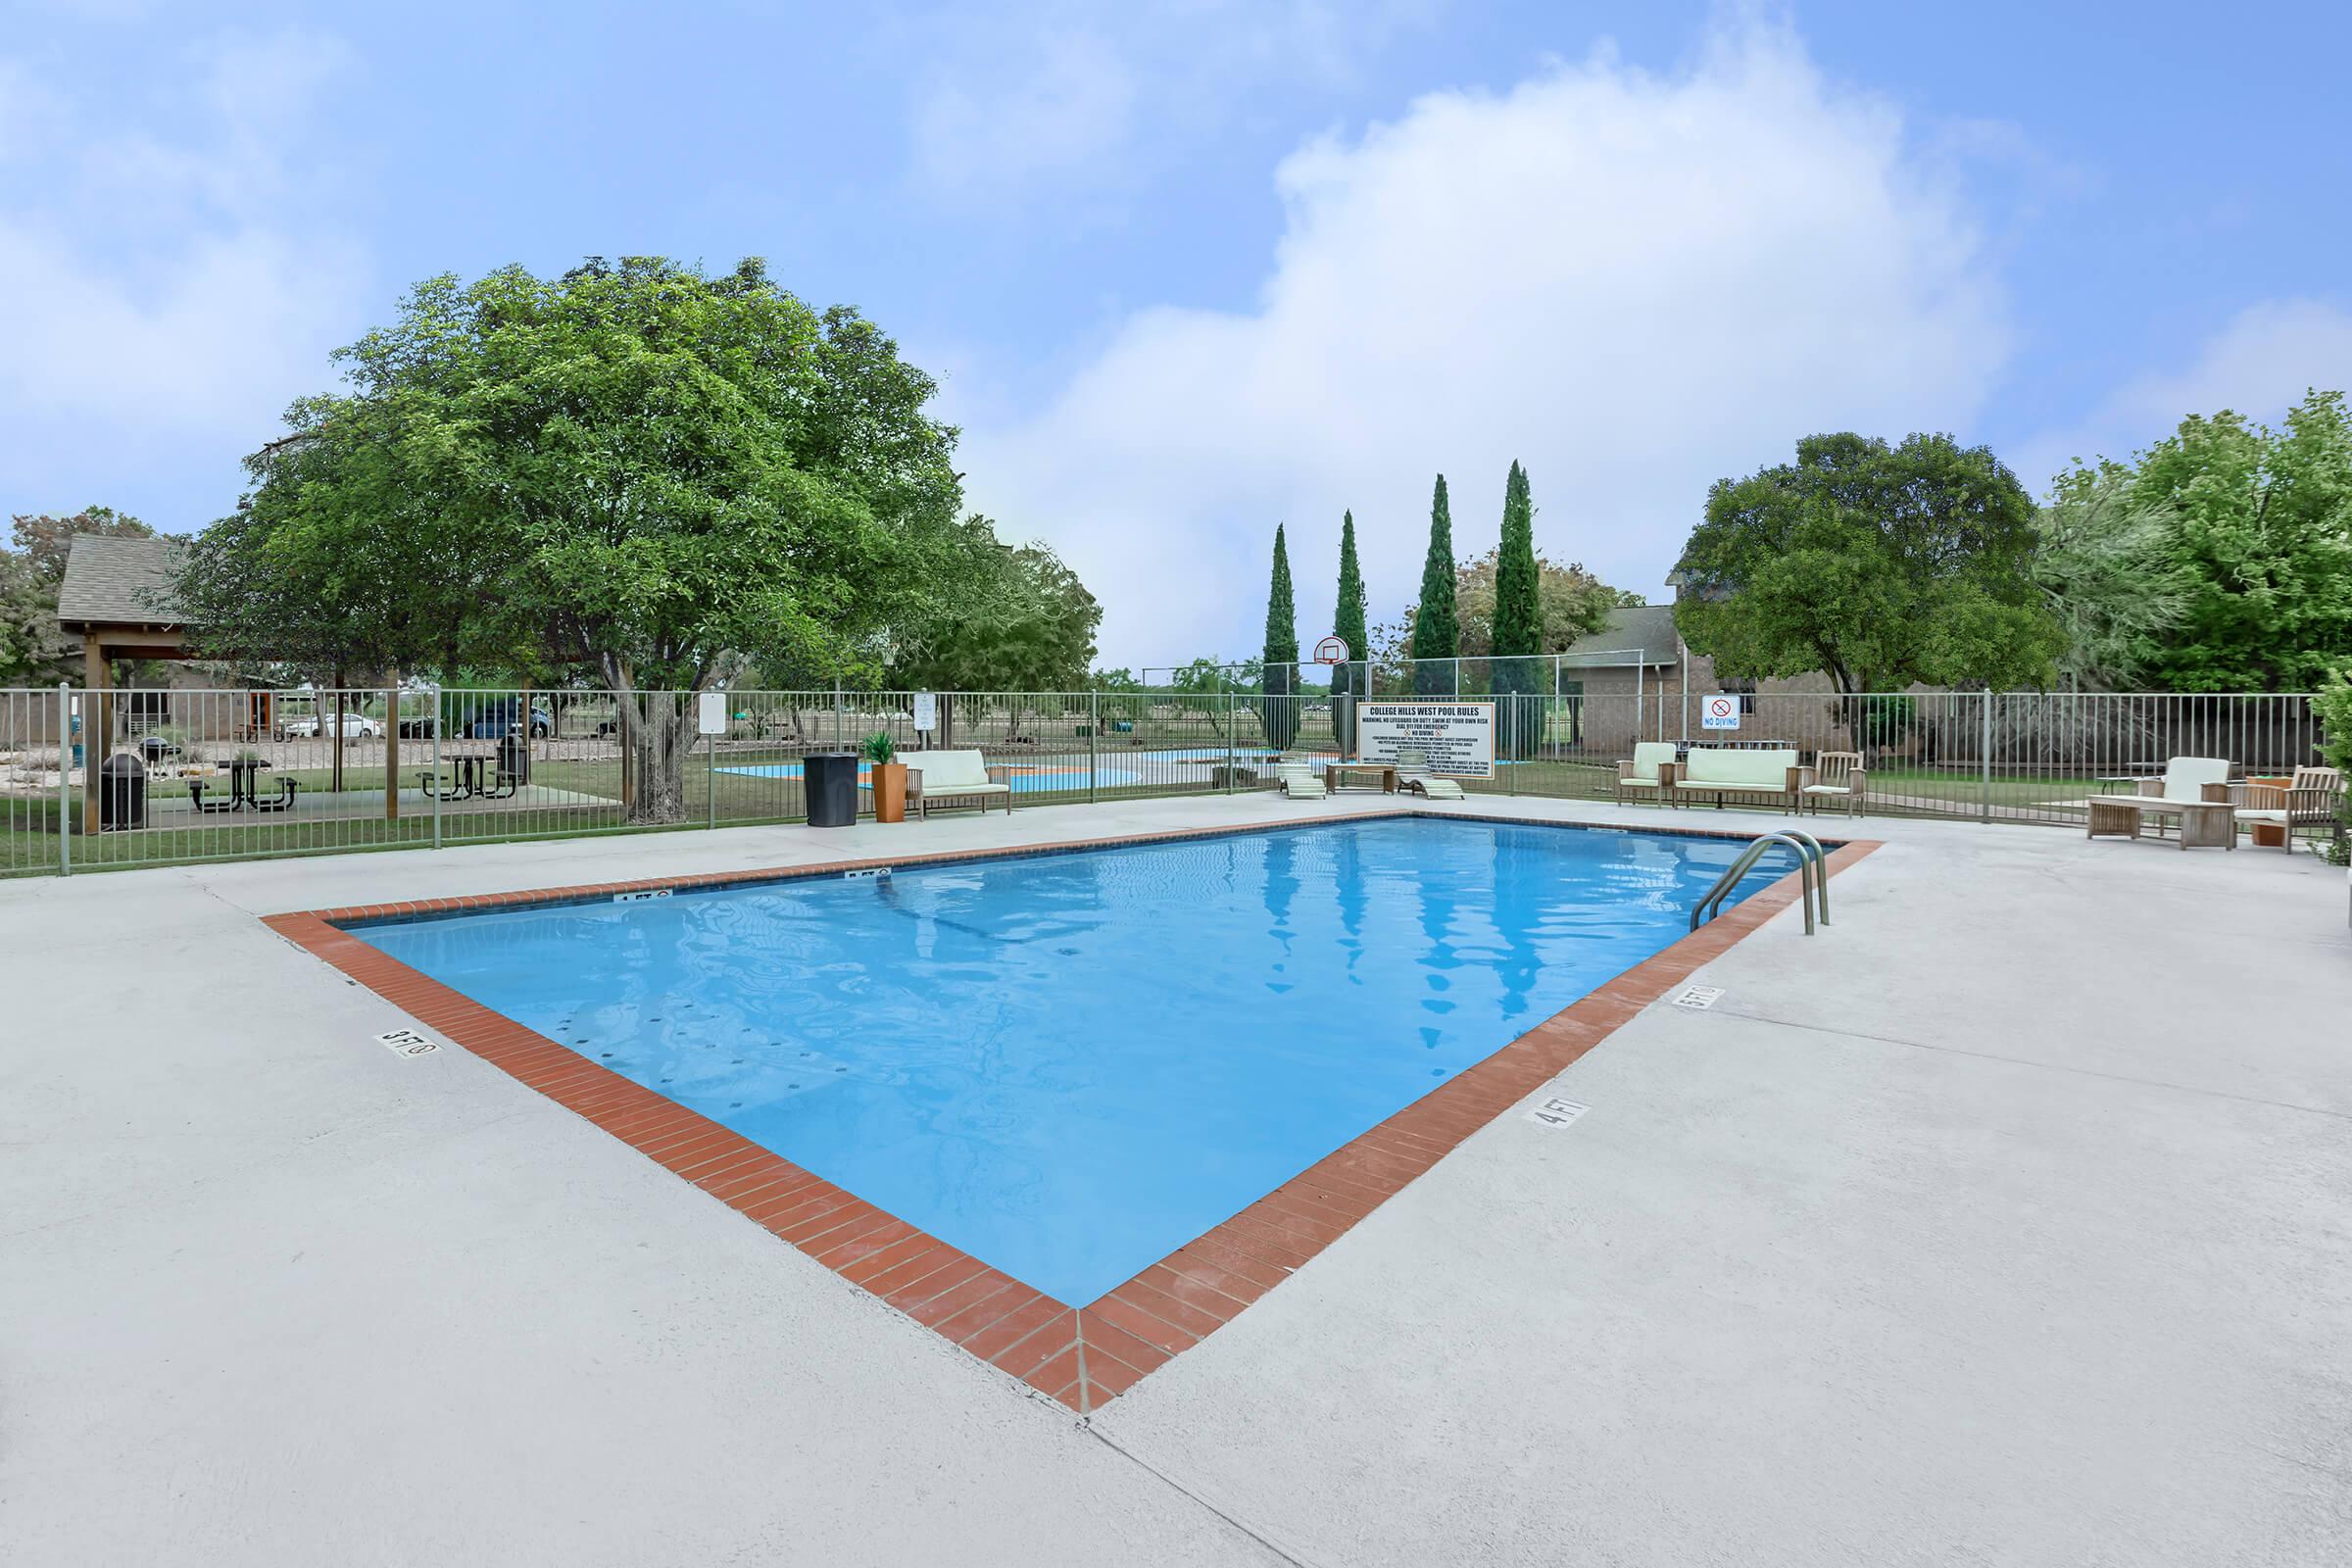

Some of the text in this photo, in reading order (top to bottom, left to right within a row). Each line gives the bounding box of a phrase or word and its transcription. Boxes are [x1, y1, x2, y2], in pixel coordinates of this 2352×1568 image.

[1370, 706, 1479, 716] COLLEGE HILLS WEST POOL RULES
[1705, 717, 1737, 726] NO DIVING
[1534, 1099, 1583, 1124] 4 FT
